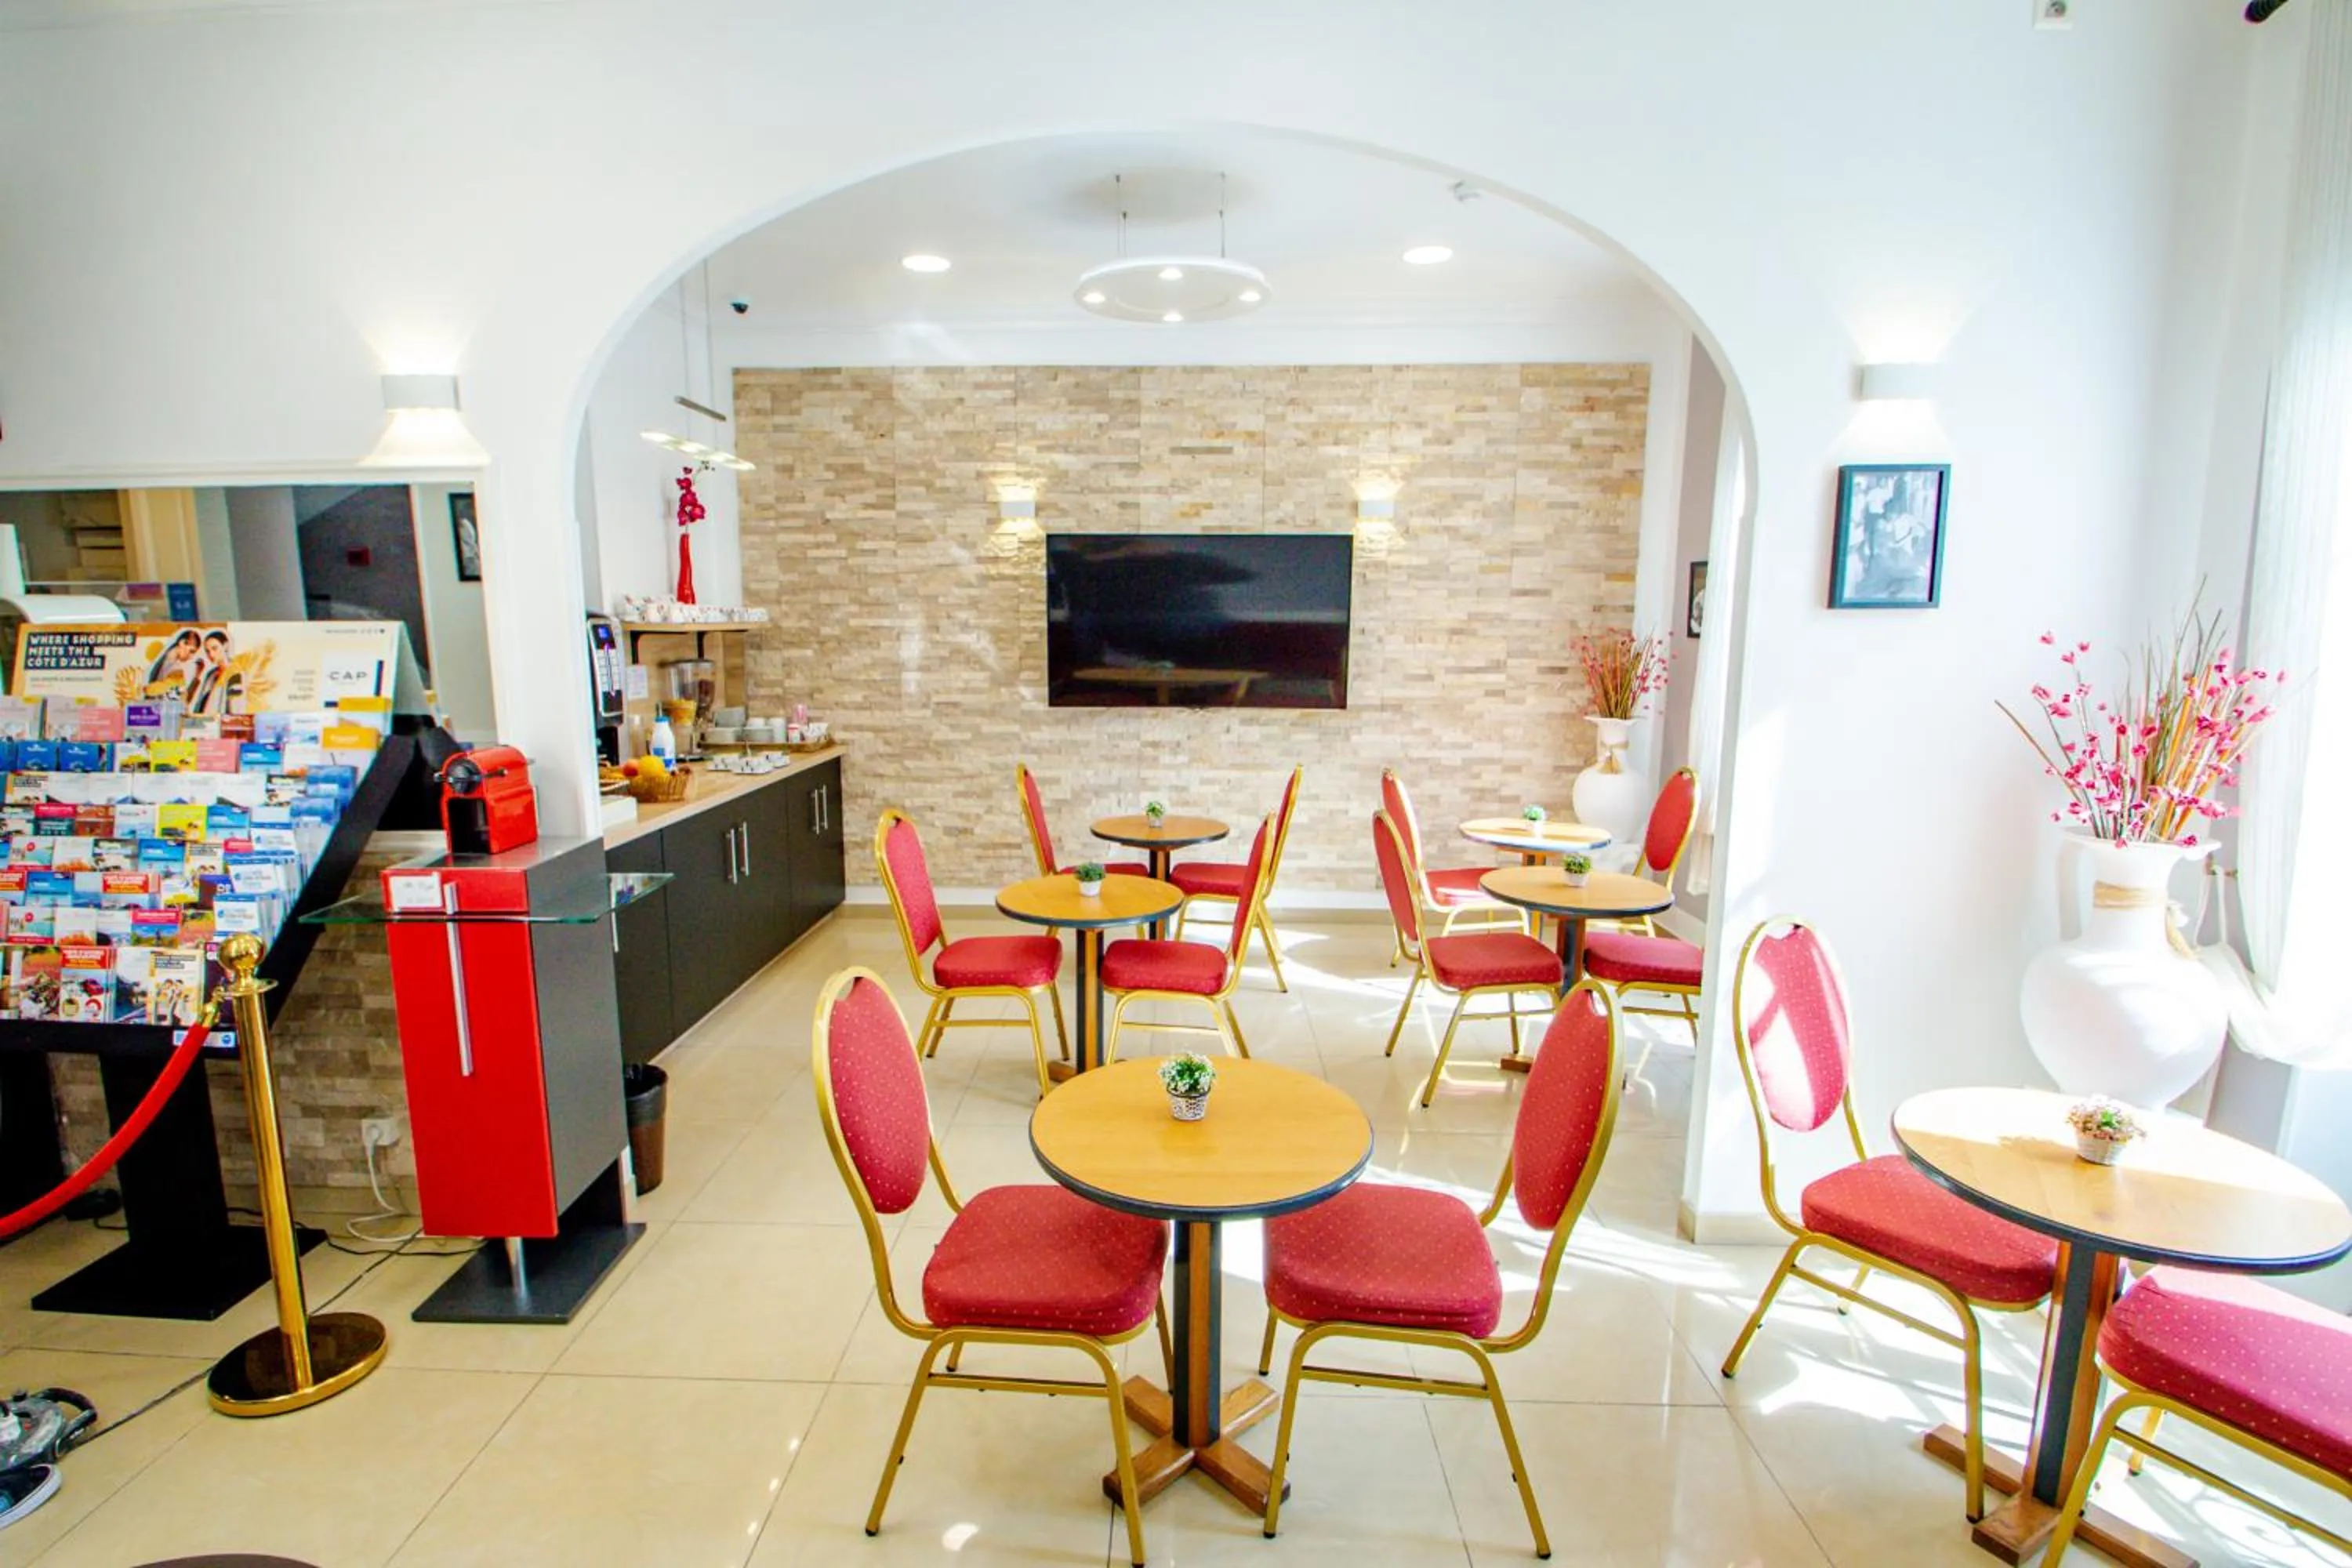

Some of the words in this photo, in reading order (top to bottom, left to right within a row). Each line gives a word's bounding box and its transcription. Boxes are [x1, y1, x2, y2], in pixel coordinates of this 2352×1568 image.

[30, 634, 70, 644] WHERE
[73, 634, 134, 644] SHOPPING
[28, 646, 65, 655] MEETS
[68, 646, 90, 655] THE
[329, 671, 368, 681] CAP
